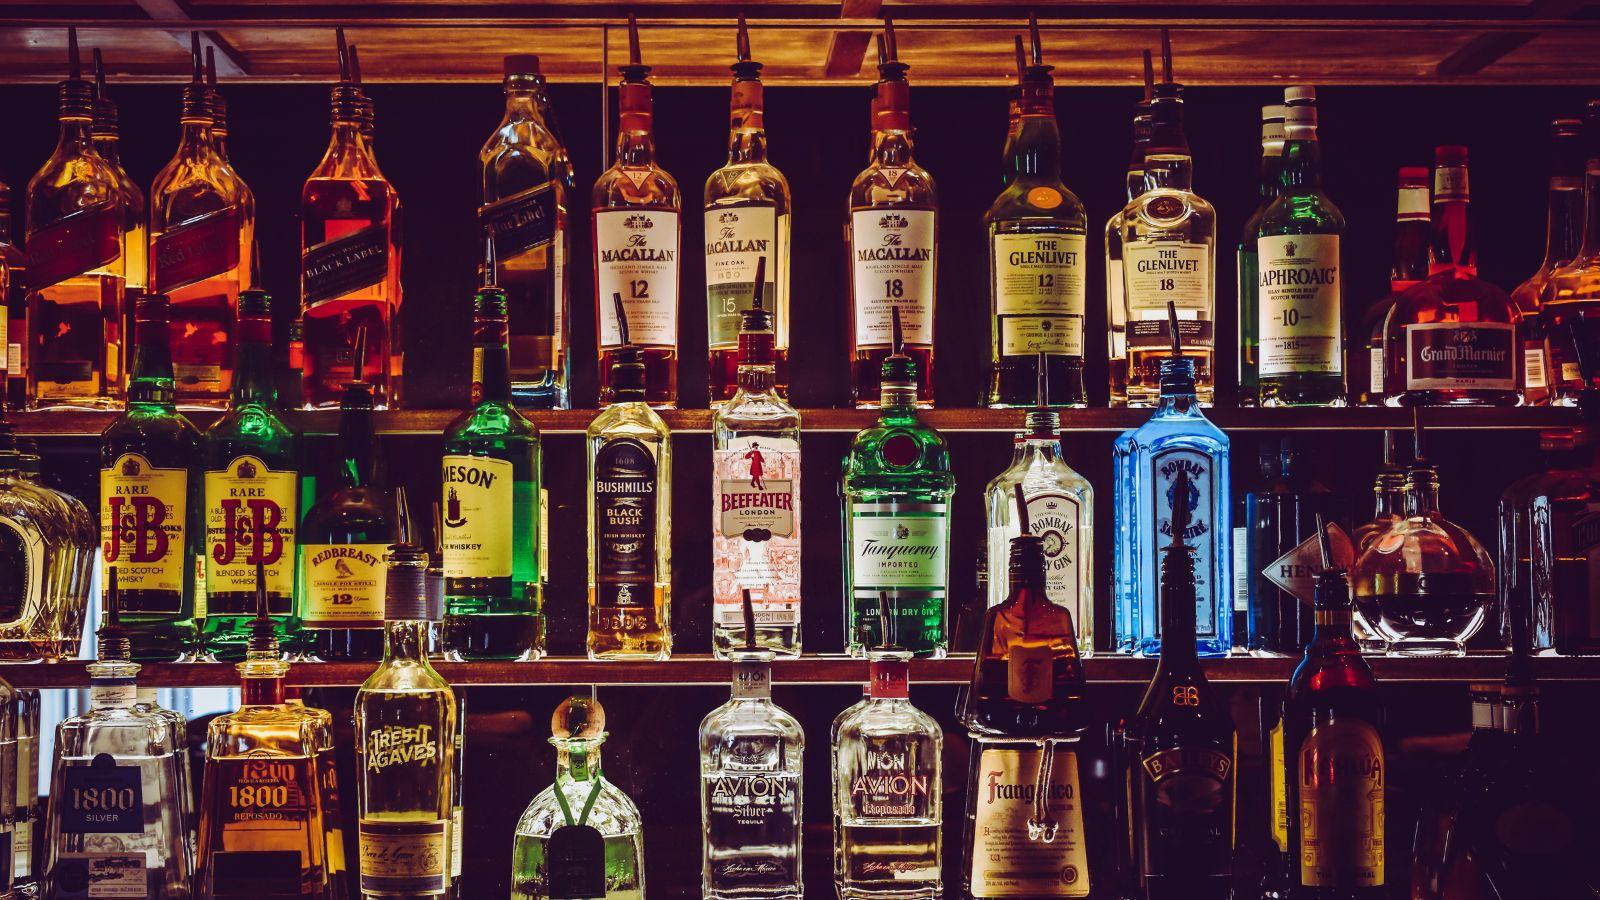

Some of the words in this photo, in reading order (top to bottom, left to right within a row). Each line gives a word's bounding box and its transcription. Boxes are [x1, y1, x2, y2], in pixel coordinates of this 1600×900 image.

[887, 169, 898, 177] 18
[627, 234, 647, 247] The
[719, 226, 735, 241] The
[881, 233, 901, 247] The
[1035, 240, 1057, 251] THE
[306, 260, 344, 278] BLACK
[346, 244, 382, 264] LABEL
[601, 248, 675, 262] MACALLAN
[858, 247, 932, 262] MACALLAN
[1009, 251, 1078, 266] GLENLIVET
[1158, 250, 1178, 259] THE
[1137, 259, 1199, 273] GLENLIVET
[1038, 274, 1054, 288] 12
[1260, 267, 1335, 287] LAPHROAIG
[630, 279, 650, 299] 12
[885, 278, 904, 298] 18
[1159, 278, 1175, 291] 18
[722, 297, 736, 313] 15
[1282, 307, 1299, 327] 10
[1283, 341, 1300, 350] 1815
[1420, 345, 1457, 362] Grand
[1457, 345, 1505, 361] Marnier
[615, 457, 635, 465] 1608
[1160, 459, 1206, 480] BOMBAY
[116, 485, 149, 495] RARE
[230, 487, 266, 497] RARE
[596, 481, 654, 493] BUSHMILLS
[721, 492, 794, 513] BEEFEATER
[606, 508, 643, 517] BLACK
[609, 517, 640, 525] BUSH
[1030, 516, 1073, 535] BOMBAY
[861, 538, 939, 560] Tanqueray
[311, 547, 379, 567] REDBREAST
[1053, 554, 1072, 571] GIN
[104, 567, 129, 575] BLDED
[130, 567, 164, 575] SCOTCH
[215, 569, 246, 577] BLENDED
[247, 569, 280, 577] SCTCH
[331, 593, 353, 605] 12
[865, 608, 899, 616] LONON
[902, 608, 919, 616] DRY
[921, 608, 934, 616] GIN
[367, 740, 437, 774] AGAVES
[1150, 752, 1229, 774] BAYS
[711, 772, 789, 798] AVIÓN
[852, 771, 929, 796] AVIÓN
[987, 770, 1074, 805] Frangico
[73, 786, 134, 811] 1800
[229, 785, 288, 808] 1800
[234, 812, 283, 821] REPOSADO
[732, 804, 767, 818] Silver
[864, 803, 916, 817] Reposado
[85, 814, 120, 822] SILVER
